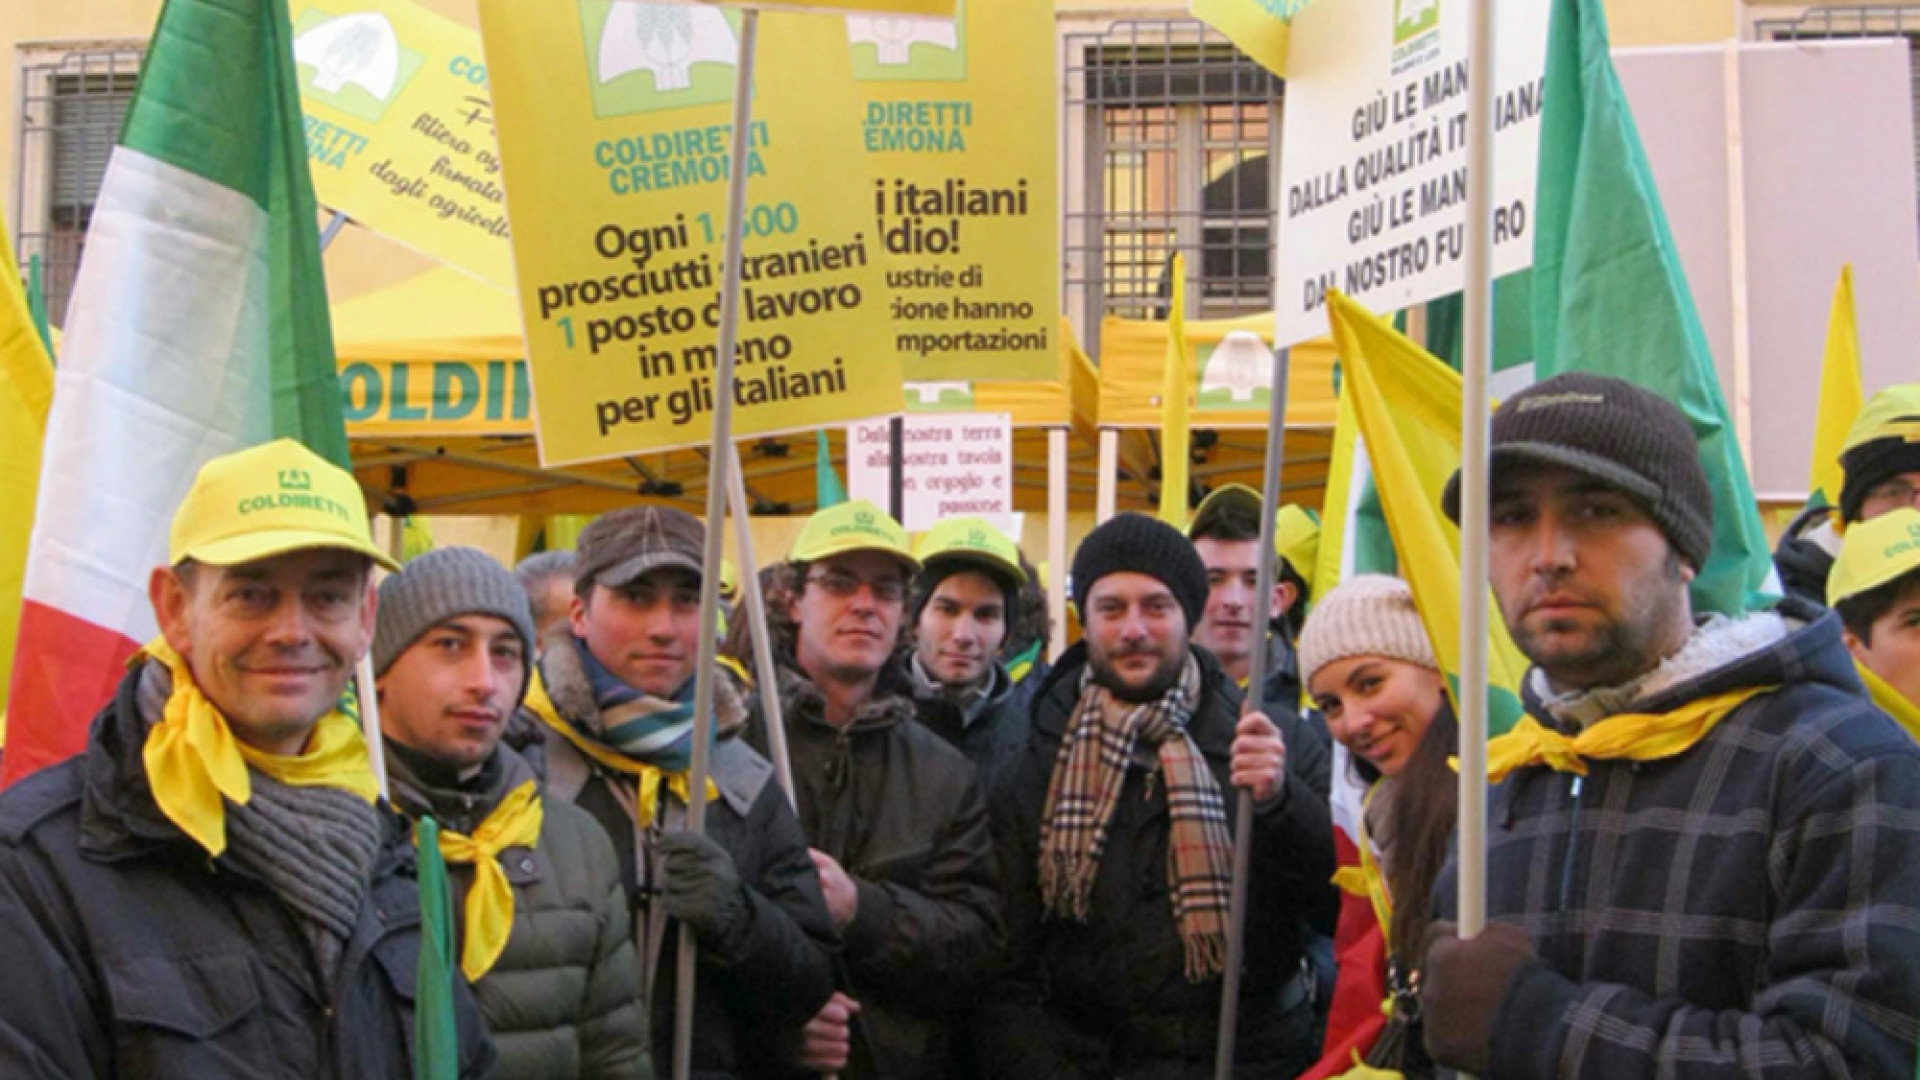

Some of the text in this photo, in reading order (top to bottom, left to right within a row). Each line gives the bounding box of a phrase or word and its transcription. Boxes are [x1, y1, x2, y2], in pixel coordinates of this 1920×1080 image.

[448, 55, 490, 89] CO
[862, 101, 973, 127] DIRETTI
[1351, 87, 1389, 142] GIÙ
[1392, 80, 1418, 124] LE
[1422, 57, 1470, 111] MAN
[864, 126, 967, 153] EMONA
[1288, 164, 1349, 219] DALLA
[1353, 114, 1442, 192] QUALITÀ
[369, 158, 511, 238] dagli agricolt
[893, 177, 1028, 217] italiani
[1348, 166, 1468, 245] GIÙ LE MAN
[594, 212, 689, 270] Ogni
[876, 216, 961, 255] dio!
[1344, 235, 1430, 298] NOSTRO
[1434, 199, 1527, 266] FURO
[538, 232, 867, 319] prosciutti tranieri
[886, 263, 983, 289] ustrie di
[557, 316, 575, 349] 1
[587, 304, 696, 353] posto
[745, 283, 863, 322] lavoro
[953, 295, 1034, 321] hanno
[638, 344, 674, 379] in
[895, 326, 1048, 357] mportazioni
[339, 359, 530, 422] OLDI
[596, 357, 847, 436] per gli taliani
[237, 492, 350, 521] COLDIRETTI
